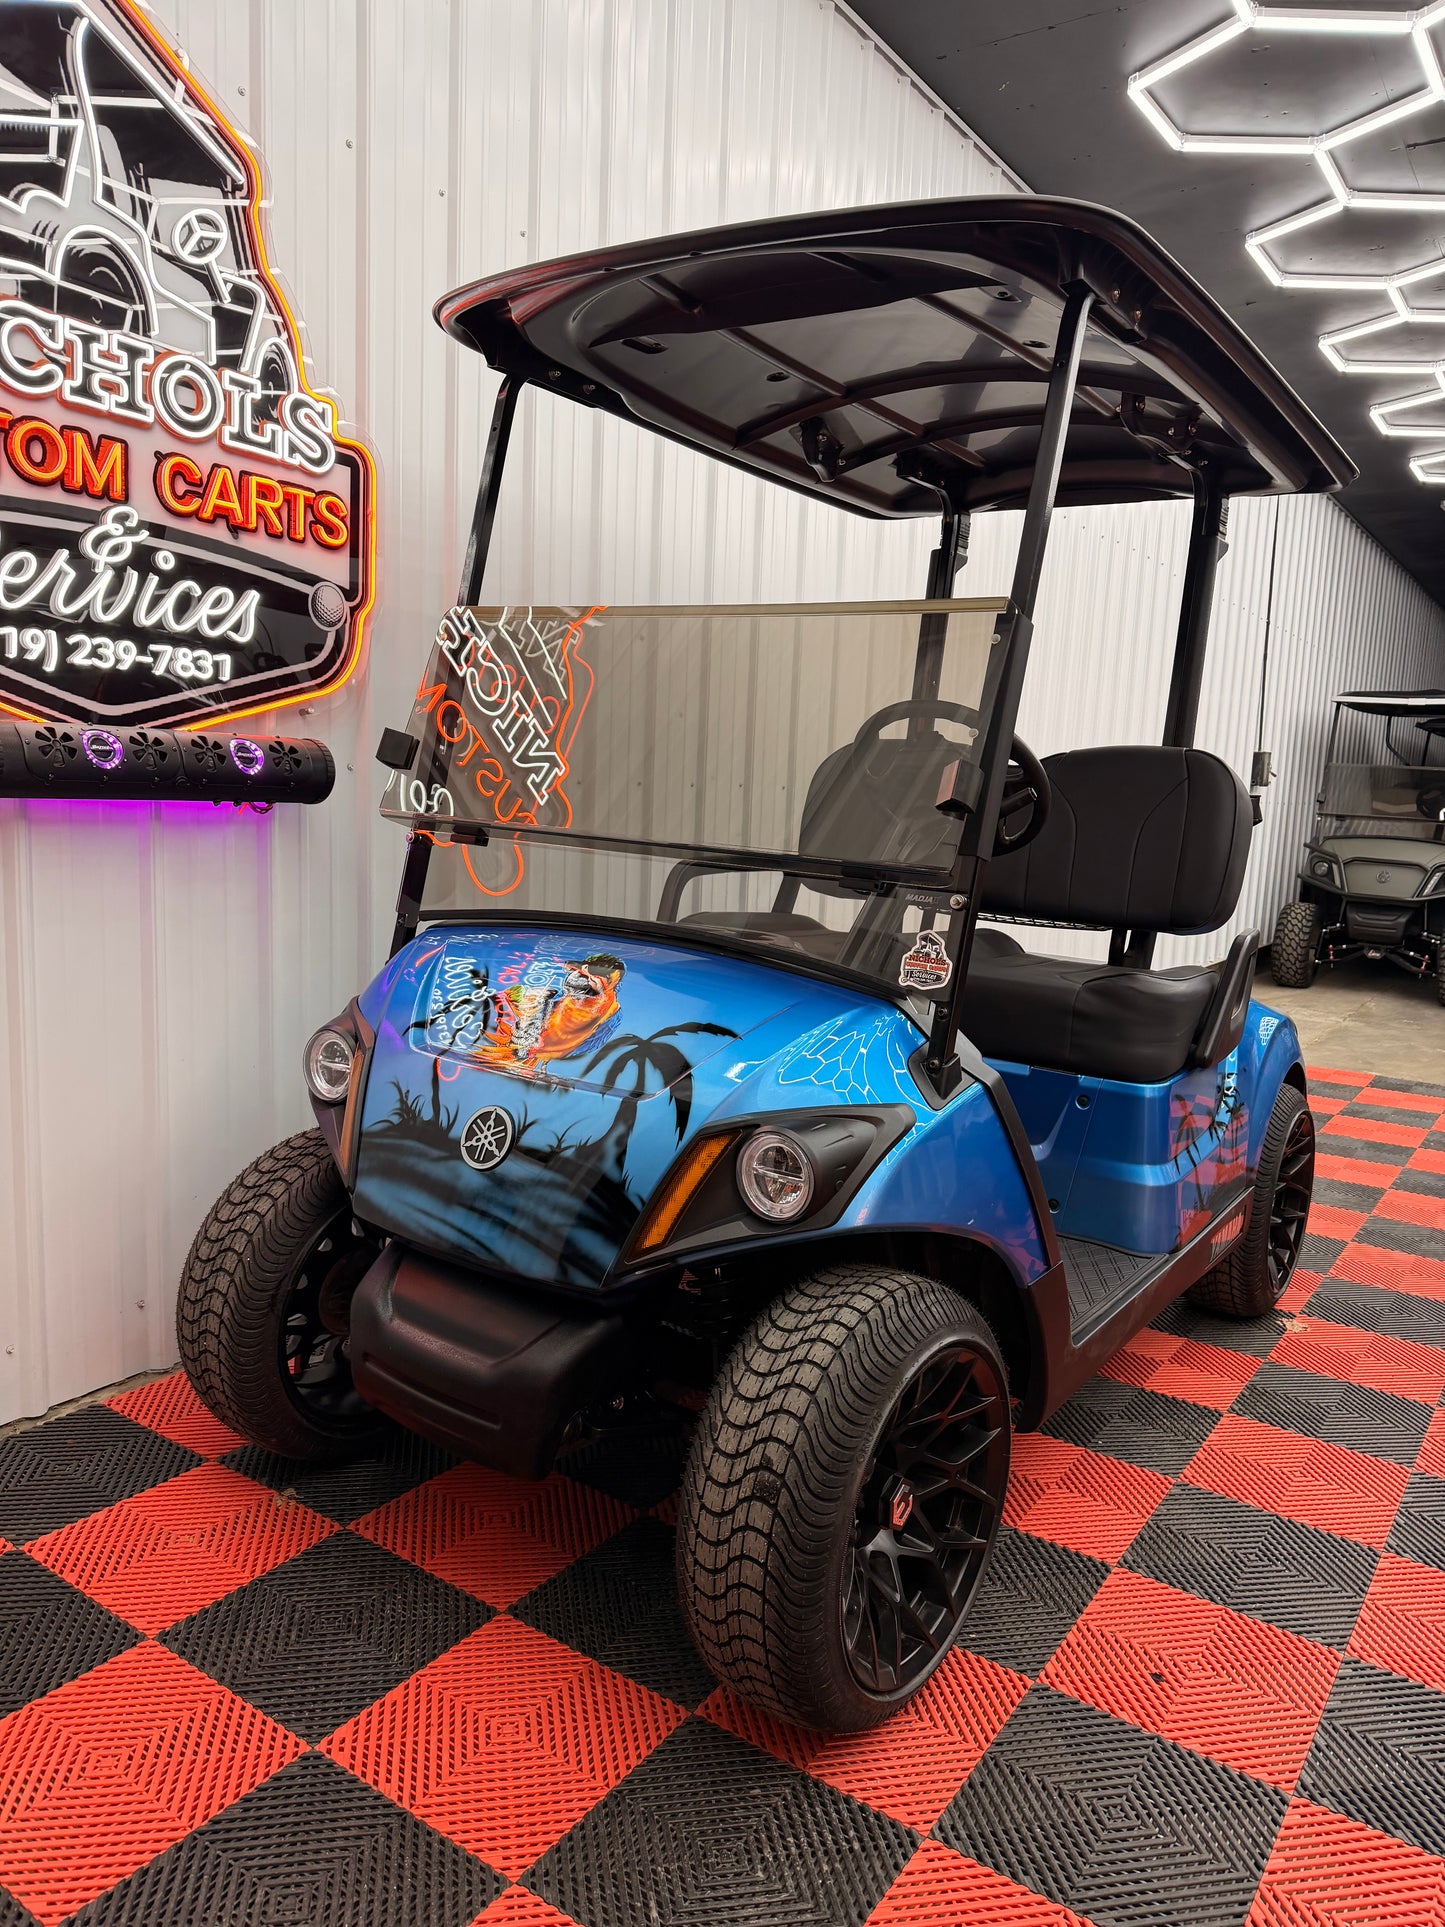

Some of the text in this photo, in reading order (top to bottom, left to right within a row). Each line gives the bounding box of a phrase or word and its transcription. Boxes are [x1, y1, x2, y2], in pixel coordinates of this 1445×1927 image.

[154, 452, 349, 549] CARTS
[79, 506, 150, 571] &
[65, 633, 232, 682] 239-7831
